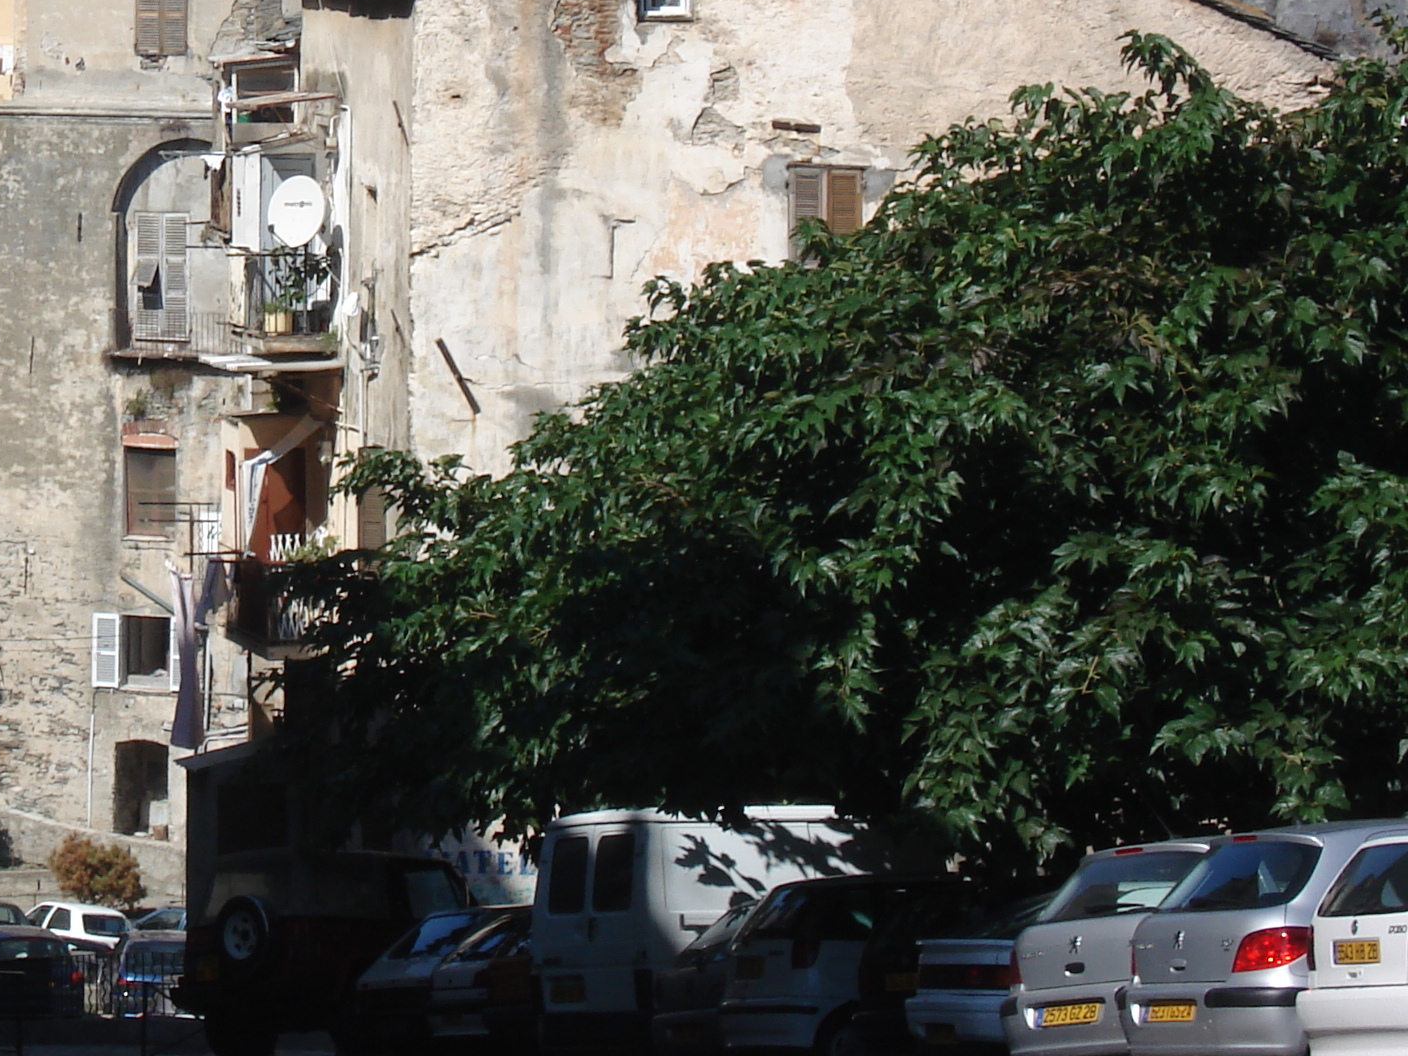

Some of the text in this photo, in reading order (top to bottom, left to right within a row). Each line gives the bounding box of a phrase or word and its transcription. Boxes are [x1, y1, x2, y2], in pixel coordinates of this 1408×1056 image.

[1043, 1004, 1097, 1023] 2573 GZ 2B
